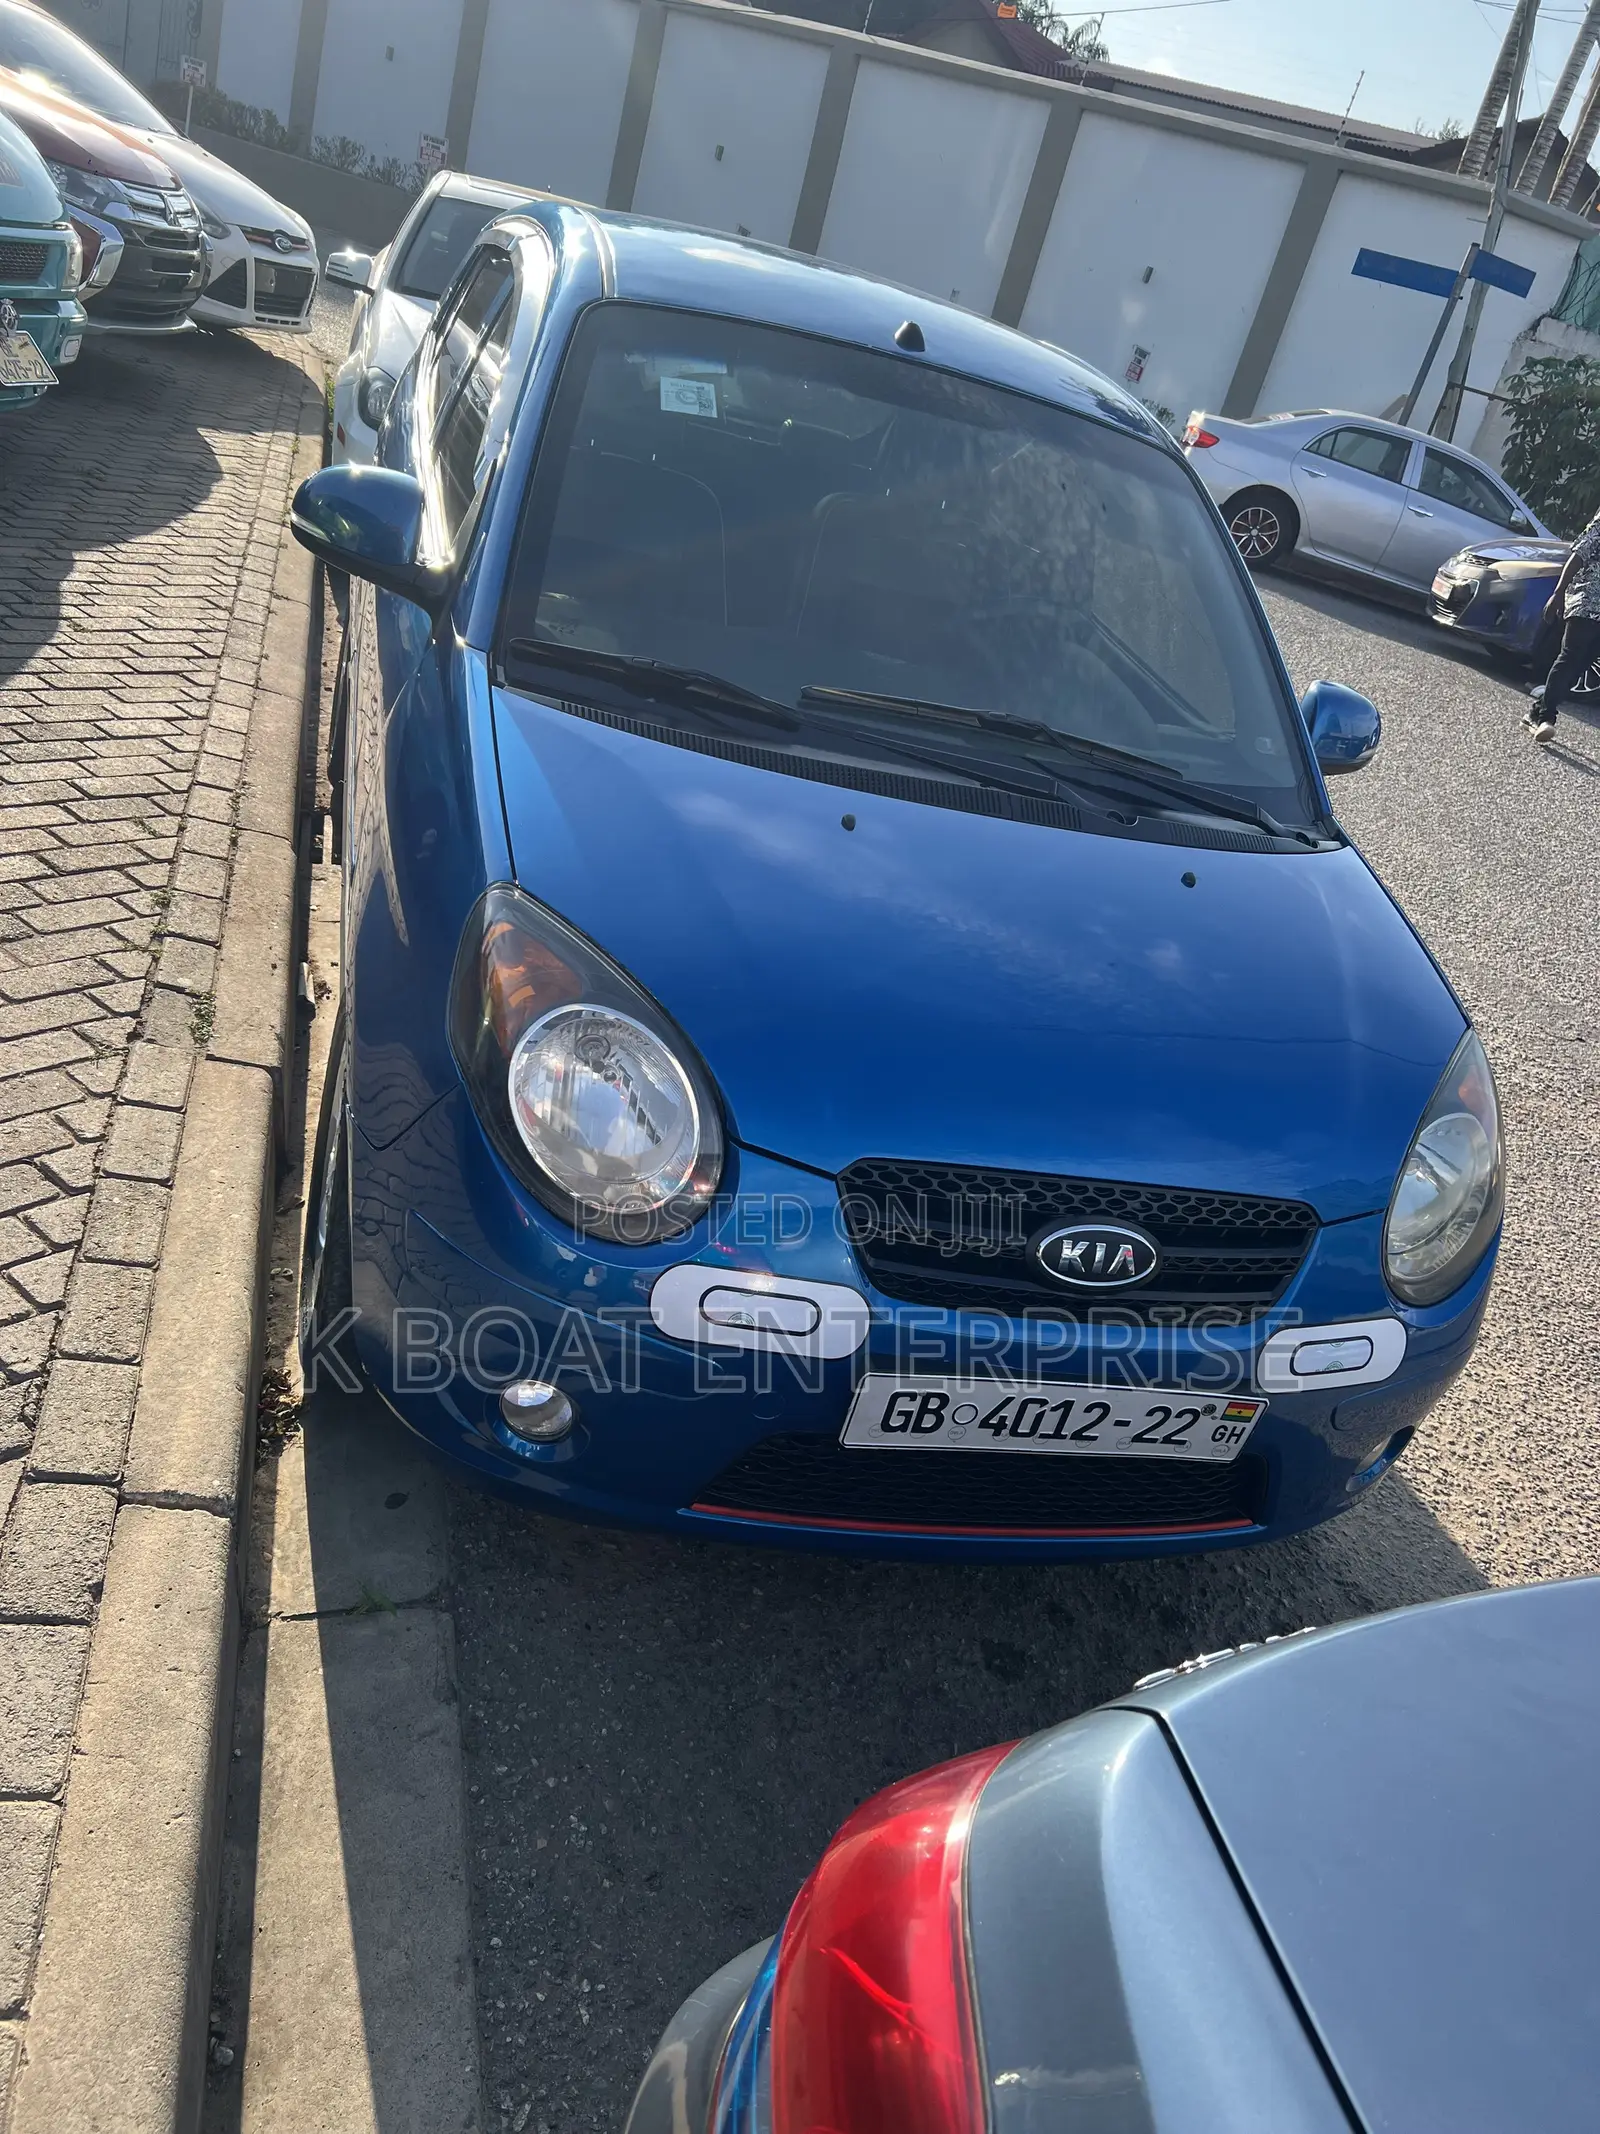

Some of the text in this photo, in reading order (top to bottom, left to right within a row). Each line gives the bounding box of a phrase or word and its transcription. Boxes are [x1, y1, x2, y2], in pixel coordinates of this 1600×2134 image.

[1058, 1239, 1136, 1276] KIA
[880, 1389, 1202, 1446] GB 4012-22
[1210, 1424, 1247, 1446] GH
